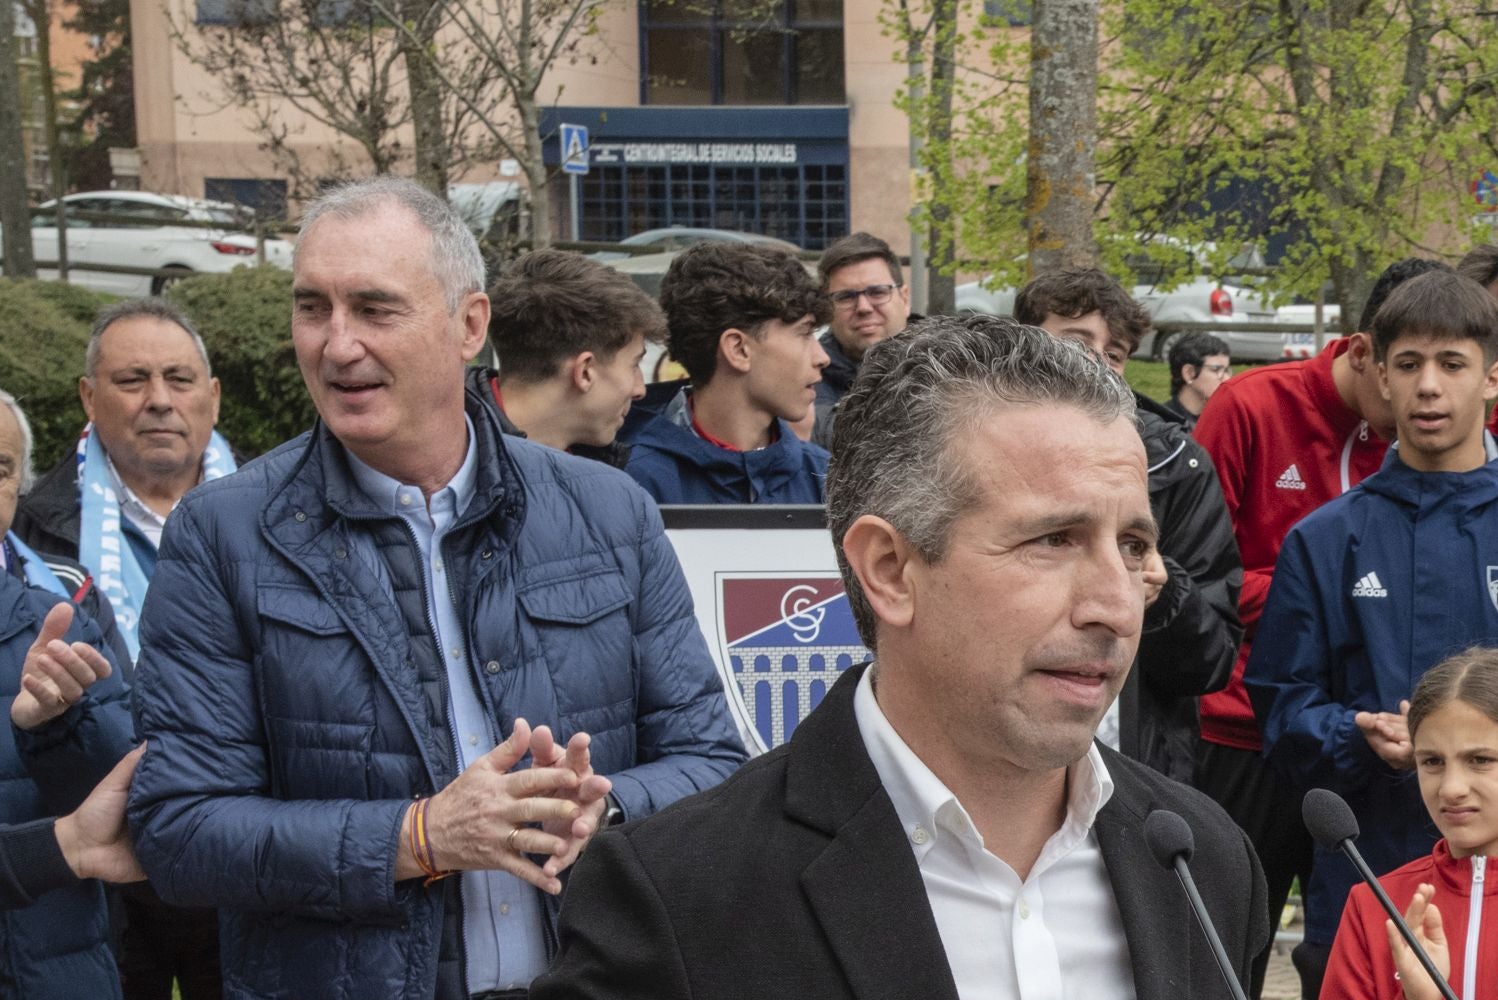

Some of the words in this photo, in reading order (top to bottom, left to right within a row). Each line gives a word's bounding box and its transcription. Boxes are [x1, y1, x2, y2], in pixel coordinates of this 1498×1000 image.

[712, 143, 754, 163] SERVICIOS
[756, 143, 797, 163] SOCIALES
[1275, 480, 1306, 490] adidas
[1352, 588, 1387, 598] adidas
